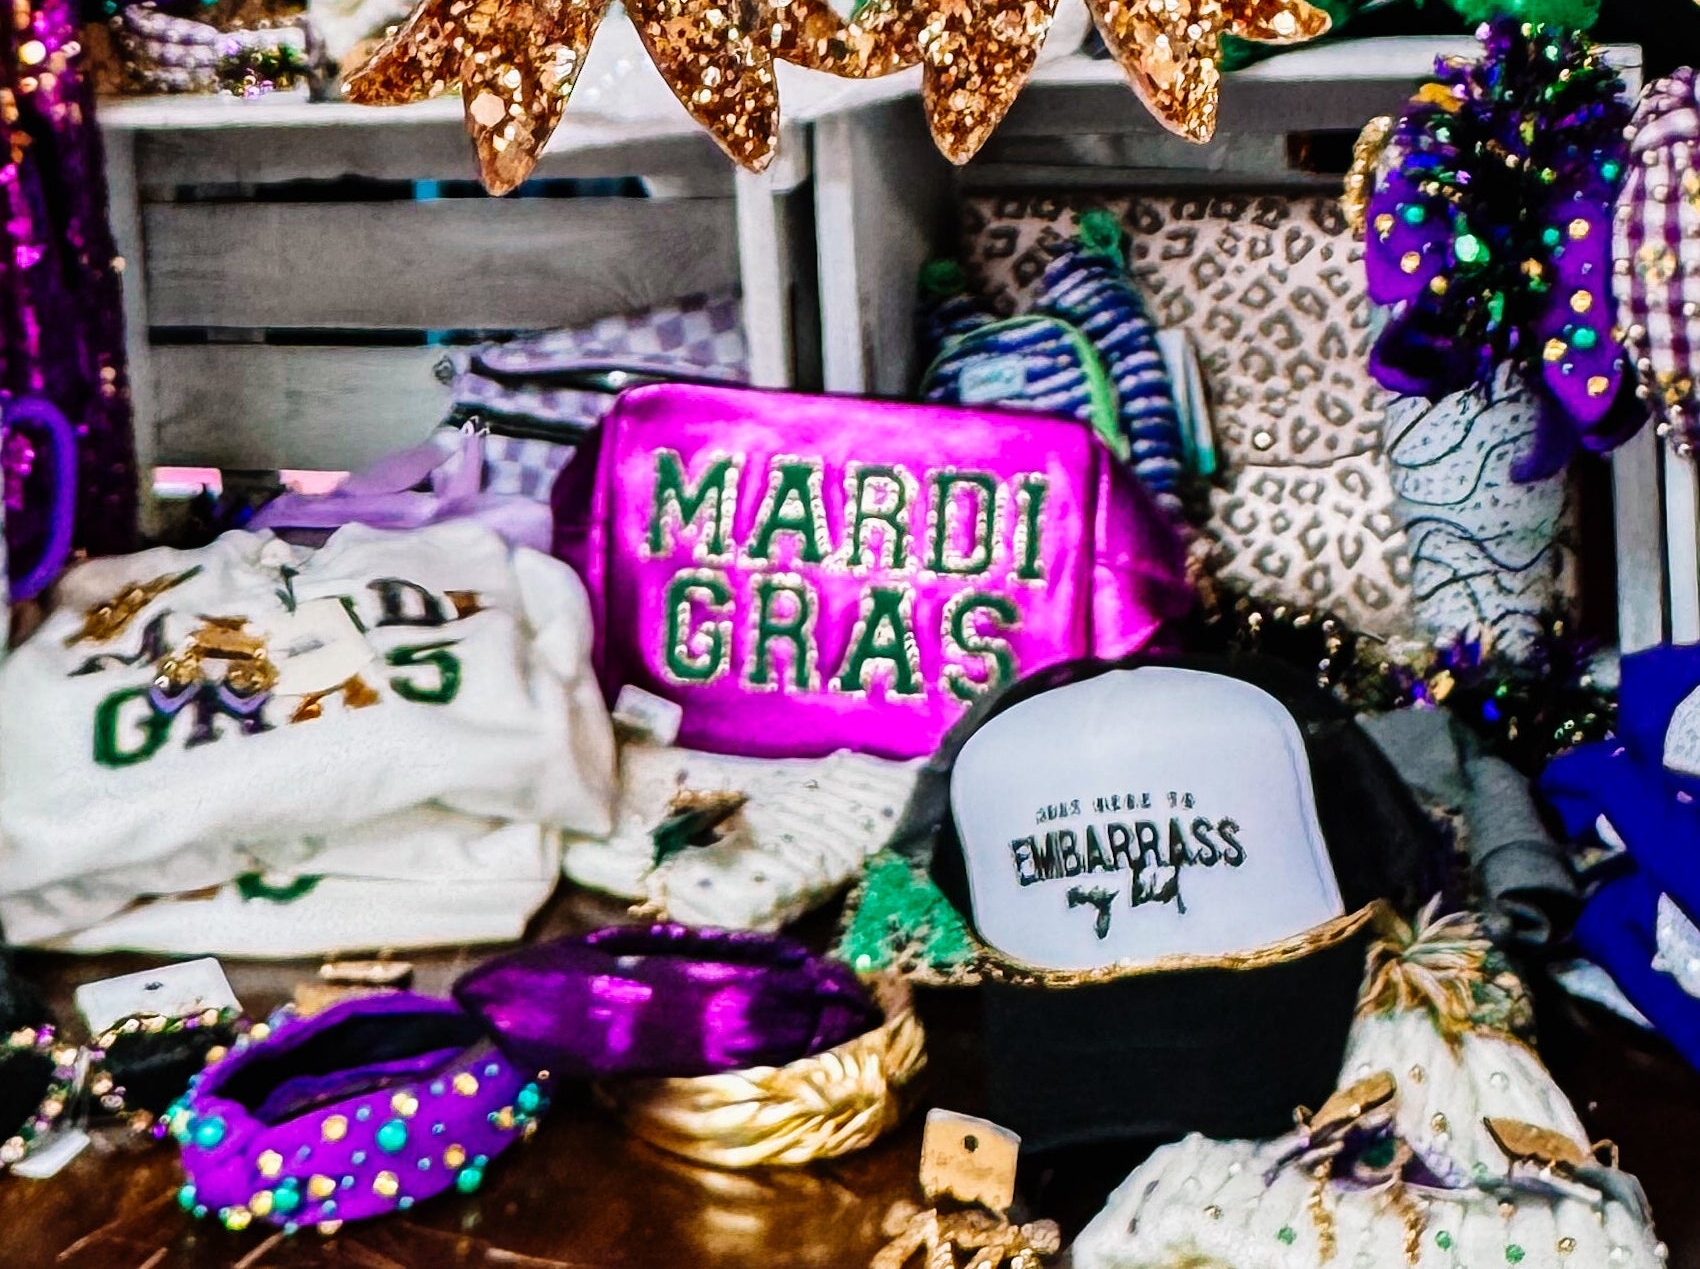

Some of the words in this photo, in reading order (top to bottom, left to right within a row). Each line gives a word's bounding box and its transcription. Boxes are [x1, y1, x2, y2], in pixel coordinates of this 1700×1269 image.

[638, 447, 1051, 590] MARDI
[662, 567, 1024, 706] GRAS
[1010, 815, 1248, 887] EMBARRASS
